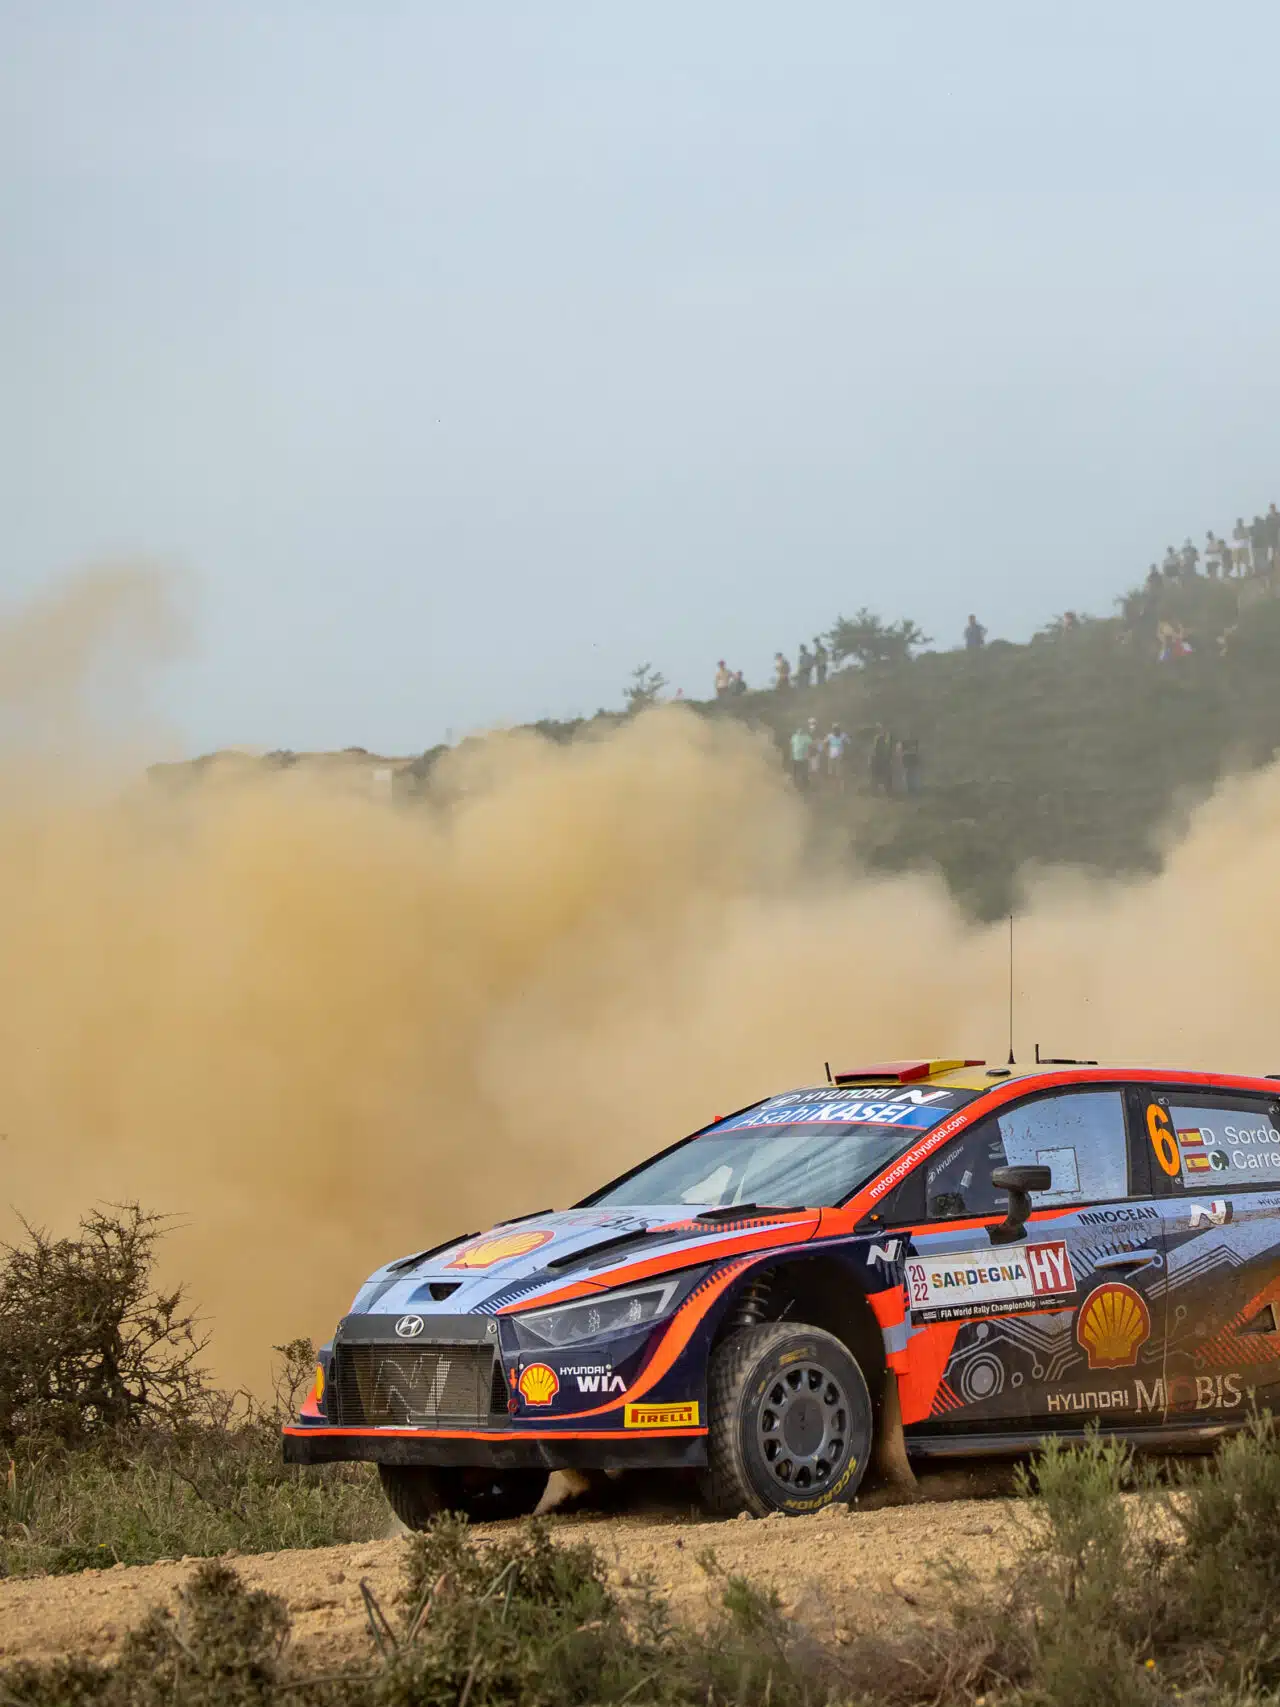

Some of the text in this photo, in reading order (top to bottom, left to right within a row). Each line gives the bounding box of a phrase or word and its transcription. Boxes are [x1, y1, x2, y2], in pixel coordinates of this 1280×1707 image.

[798, 1088, 896, 1103] HYUNDAI
[1146, 1103, 1181, 1178] 6
[1199, 1127, 1222, 1146] D.
[869, 1114, 968, 1199] motorsport.hyundai.com
[1208, 1151, 1229, 1171] C.
[1077, 1206, 1160, 1226] INNOCEAN
[908, 1264, 927, 1284] 20
[931, 1263, 1028, 1289] SARDEGNA
[1029, 1247, 1068, 1292] HY
[913, 1283, 930, 1302] 22
[940, 1309, 952, 1319] FIA
[952, 1306, 973, 1318] World
[973, 1304, 991, 1316] Rally
[991, 1299, 1037, 1313] Championship
[559, 1366, 606, 1377] HYUNDAI
[576, 1371, 628, 1393] WIA
[1046, 1389, 1129, 1412] HYUNDAI
[630, 1405, 693, 1424] PIRELLI
